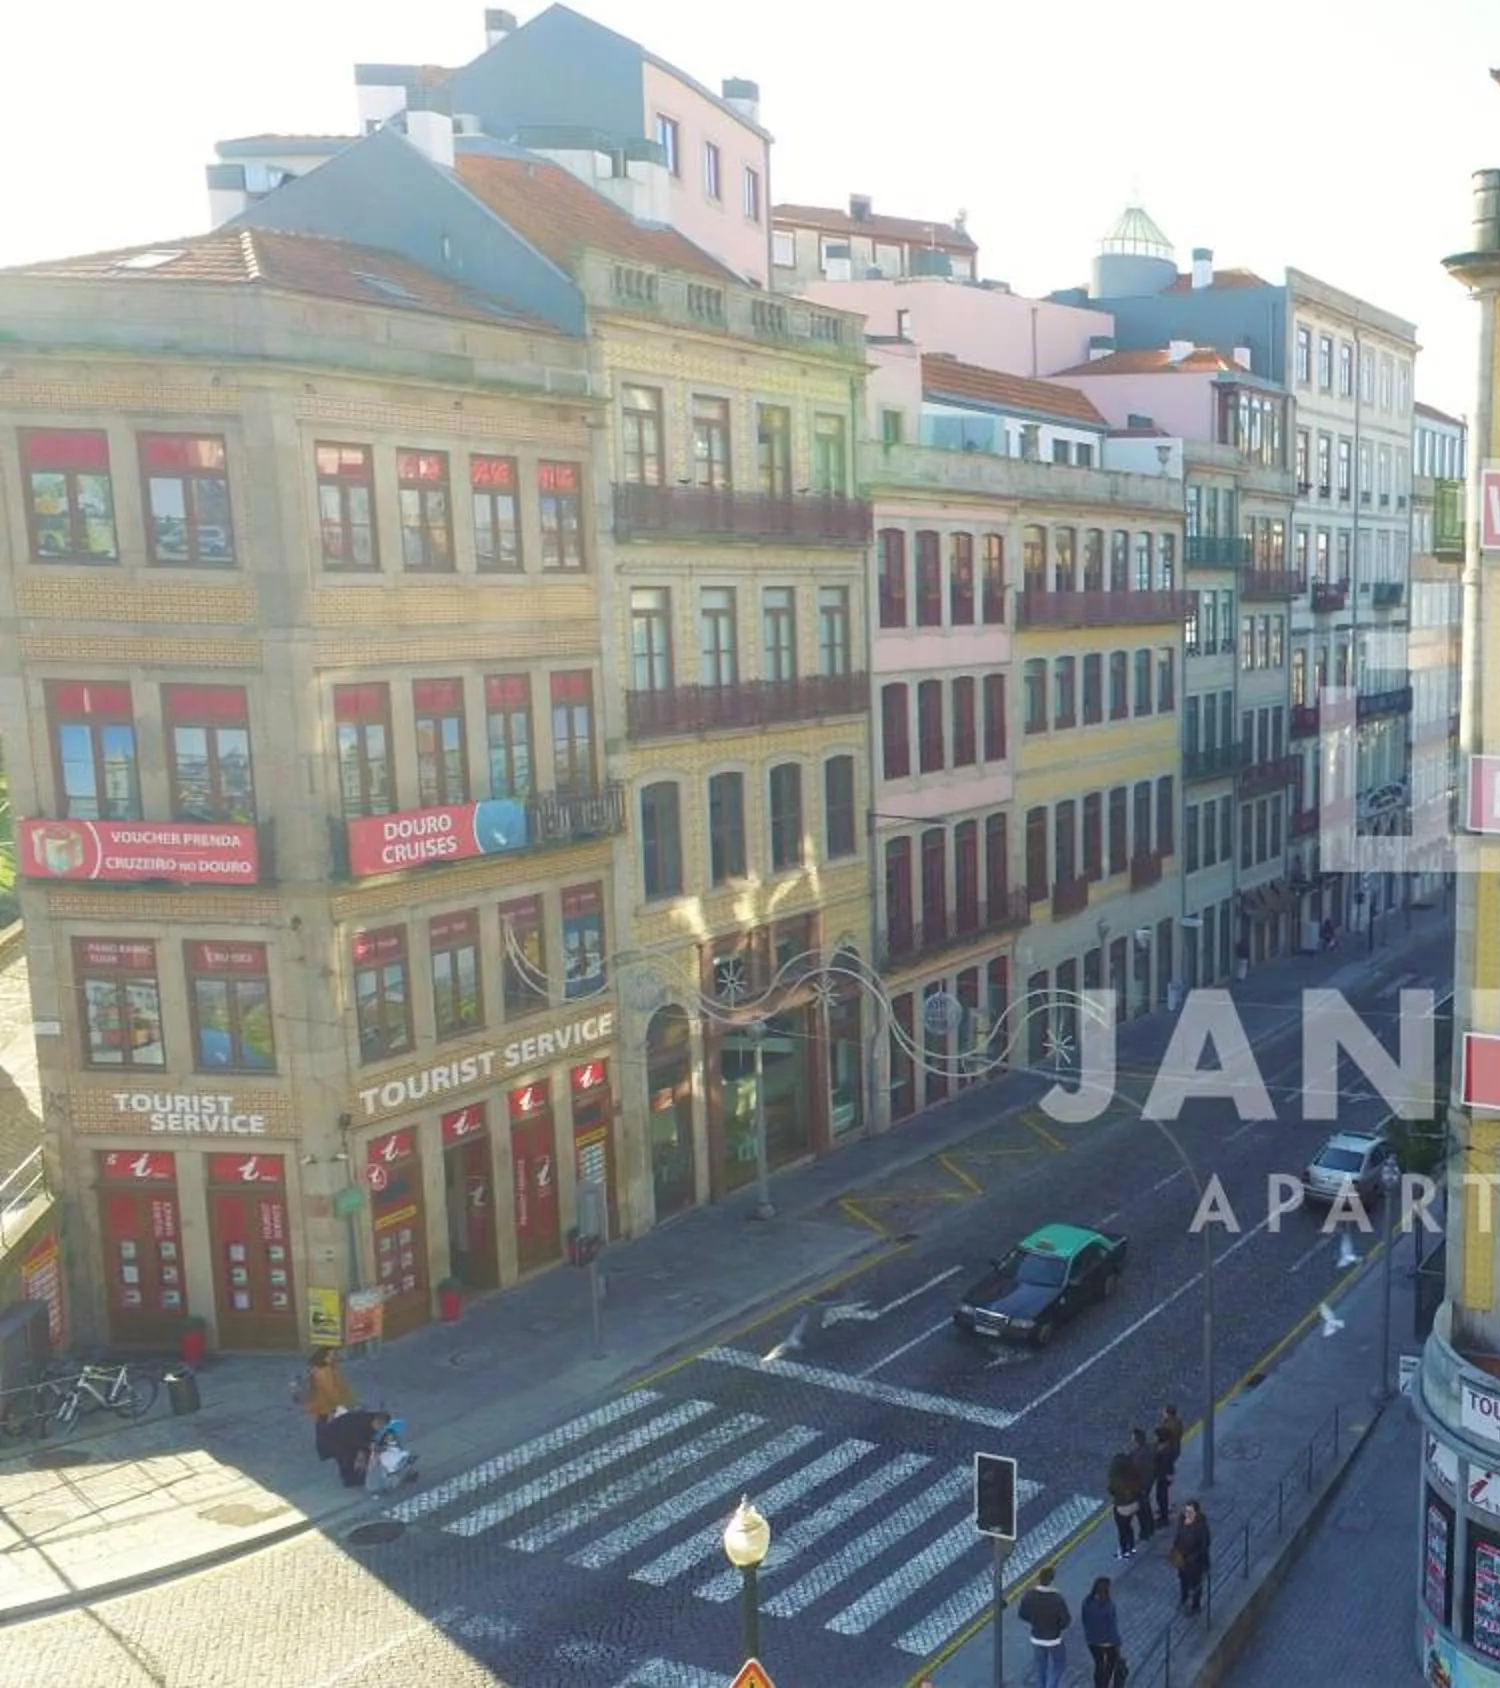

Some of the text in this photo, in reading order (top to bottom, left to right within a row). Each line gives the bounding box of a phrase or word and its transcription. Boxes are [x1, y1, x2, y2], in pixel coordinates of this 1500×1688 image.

[383, 814, 452, 841] DOURO
[110, 831, 242, 848] VOUCHER PRENDA
[381, 835, 458, 864] CRUISES
[104, 856, 177, 872] CRUZEIRO
[198, 859, 252, 874] DOURO
[359, 1012, 613, 1115] TOURIST SERVICE
[112, 1093, 234, 1114] TOURIST
[150, 1113, 266, 1133] SERVICE
